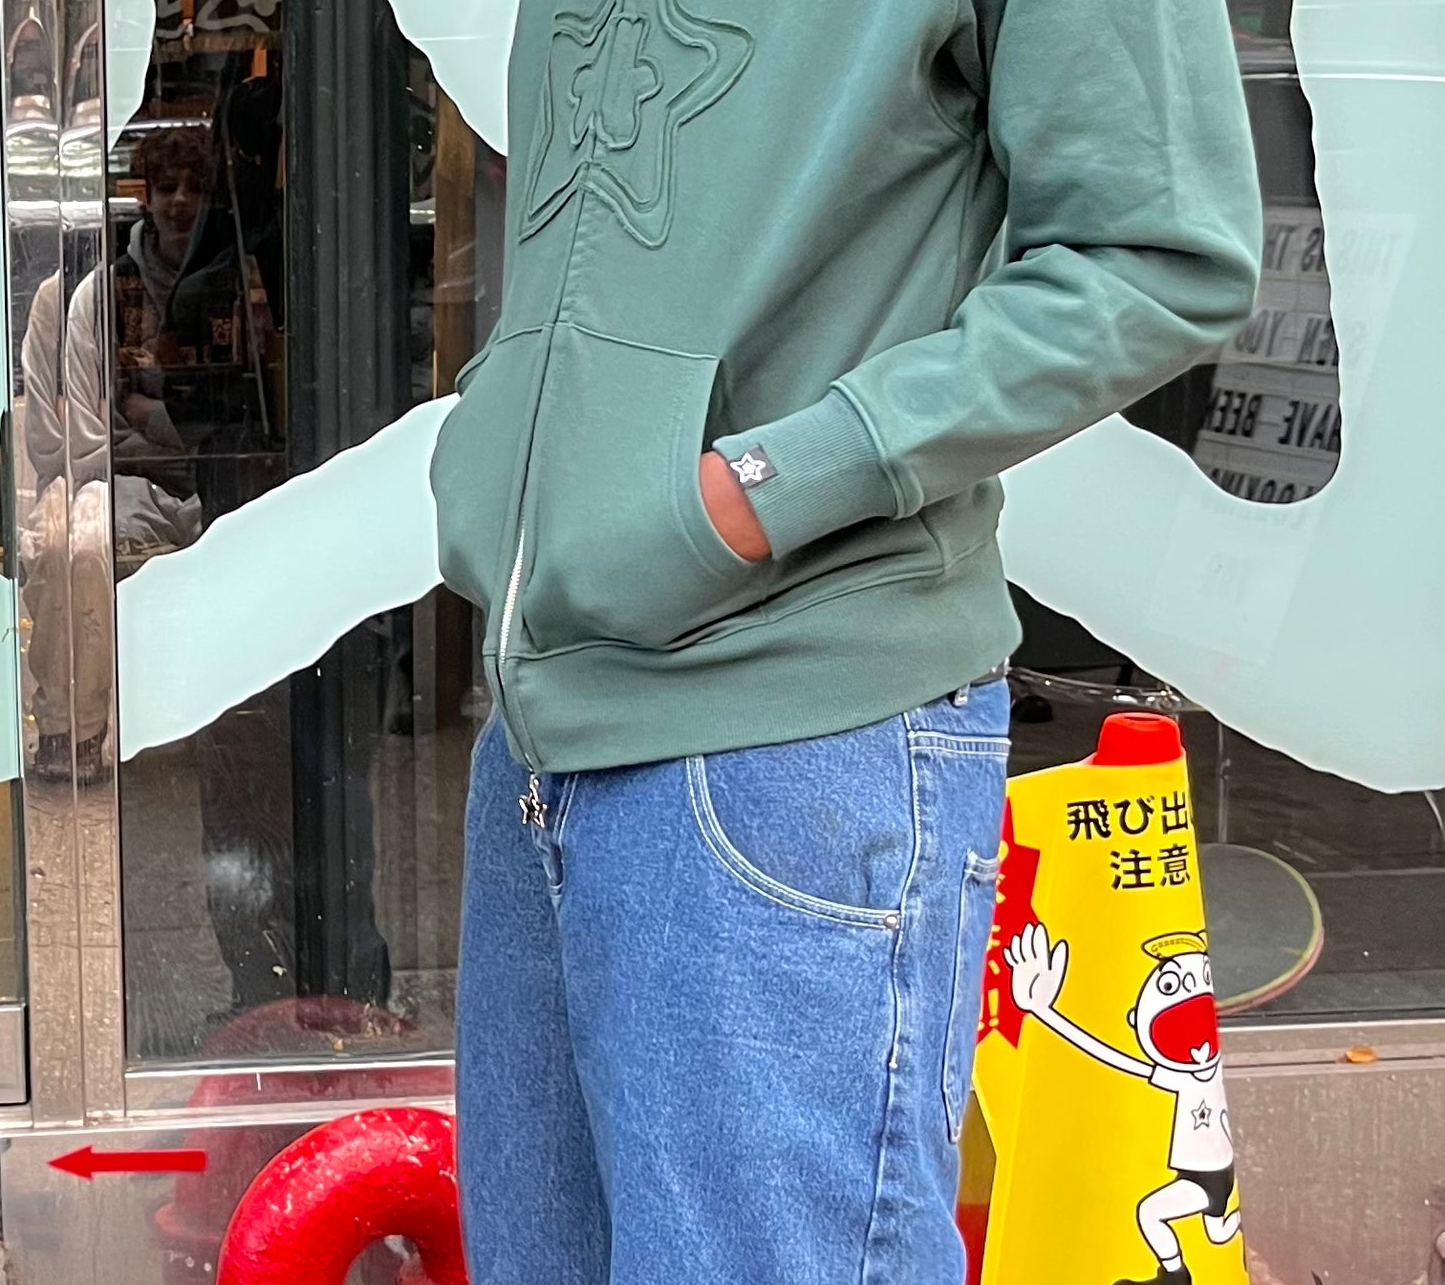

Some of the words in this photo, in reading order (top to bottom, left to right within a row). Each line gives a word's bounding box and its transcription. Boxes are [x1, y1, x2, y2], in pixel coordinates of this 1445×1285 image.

[1067, 790, 1192, 842] 飛び出
[1109, 843, 1191, 891] 注意
